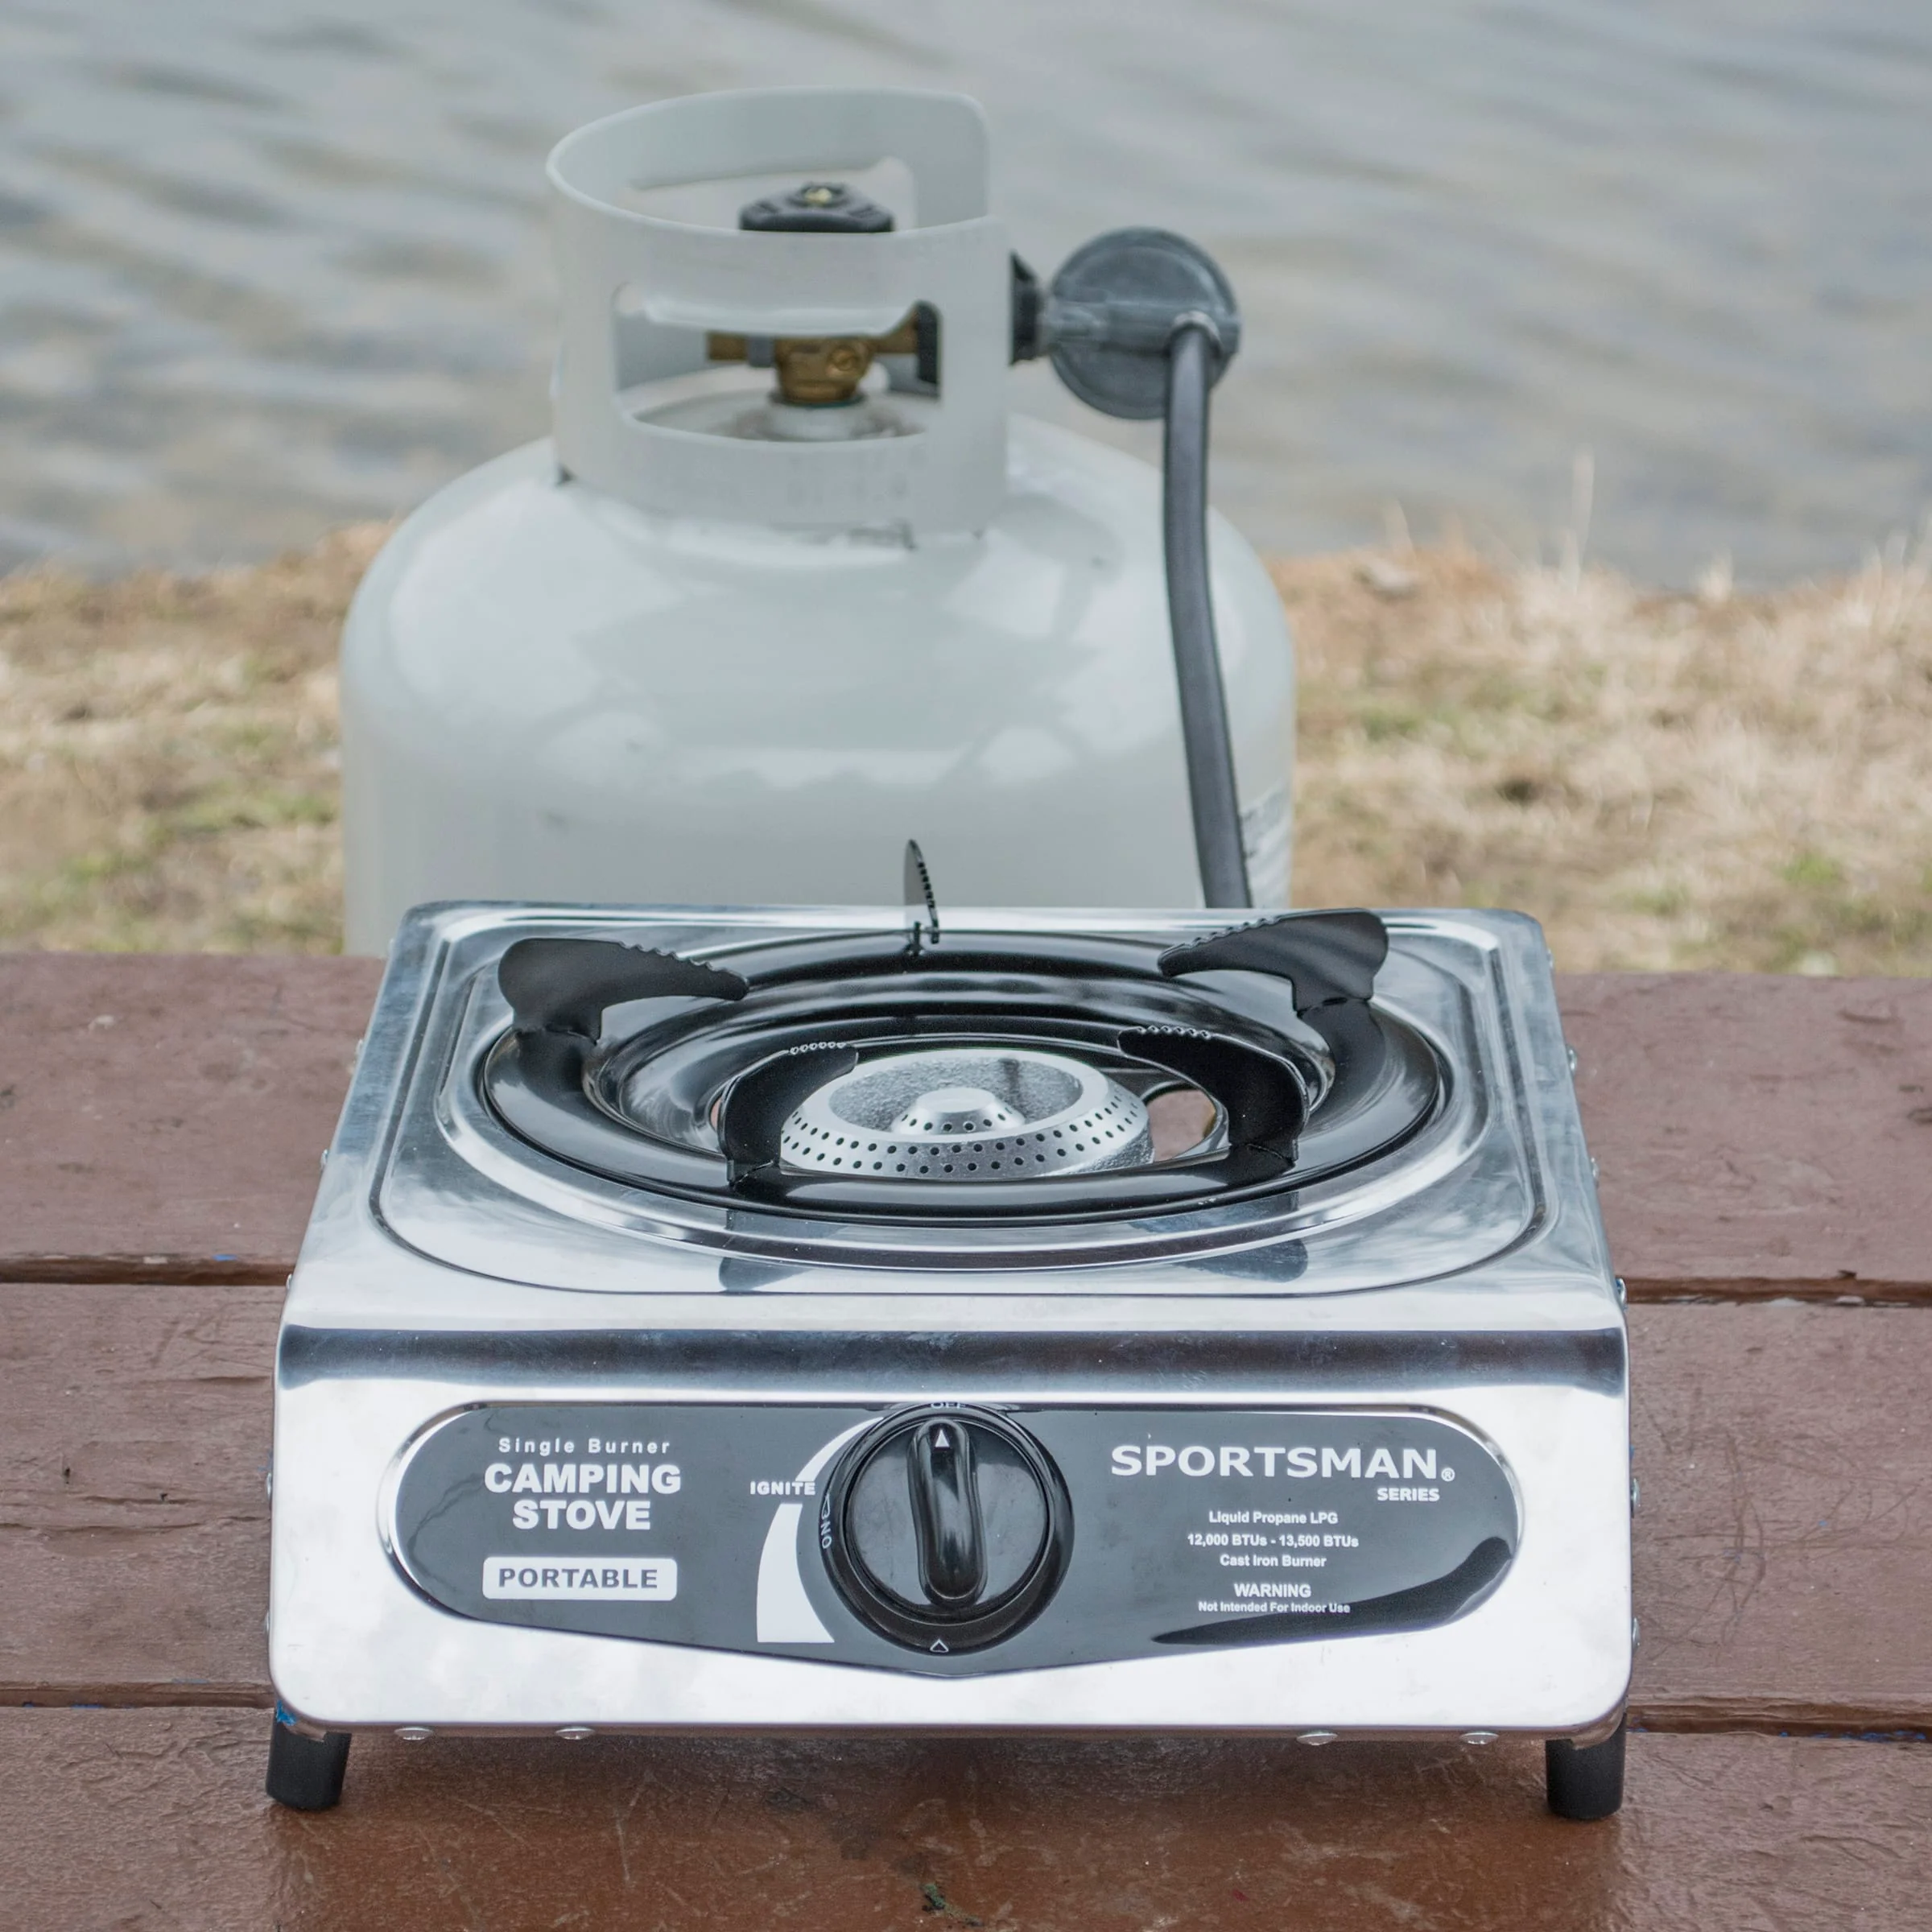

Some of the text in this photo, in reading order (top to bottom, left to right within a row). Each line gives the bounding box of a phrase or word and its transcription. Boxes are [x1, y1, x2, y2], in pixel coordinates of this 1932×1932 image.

[498, 1437, 670, 1457] Single Burner
[485, 1463, 681, 1495] CAMPING
[749, 1480, 816, 1496] IGNITE
[1377, 1487, 1440, 1502] SERIES
[512, 1499, 651, 1530] STOVE
[1208, 1510, 1339, 1526] Liquid Propane LPG
[1187, 1533, 1229, 1547] 12,000
[1232, 1533, 1268, 1546] BTUs
[1278, 1534, 1321, 1549] 13,500
[1323, 1534, 1360, 1548] BTUs
[1220, 1553, 1327, 1567] Cast Iron Burner
[499, 1568, 658, 1588] PORTABLE
[1233, 1583, 1312, 1598] WARNING
[1198, 1600, 1351, 1613] Not Intended For Indoor Use
